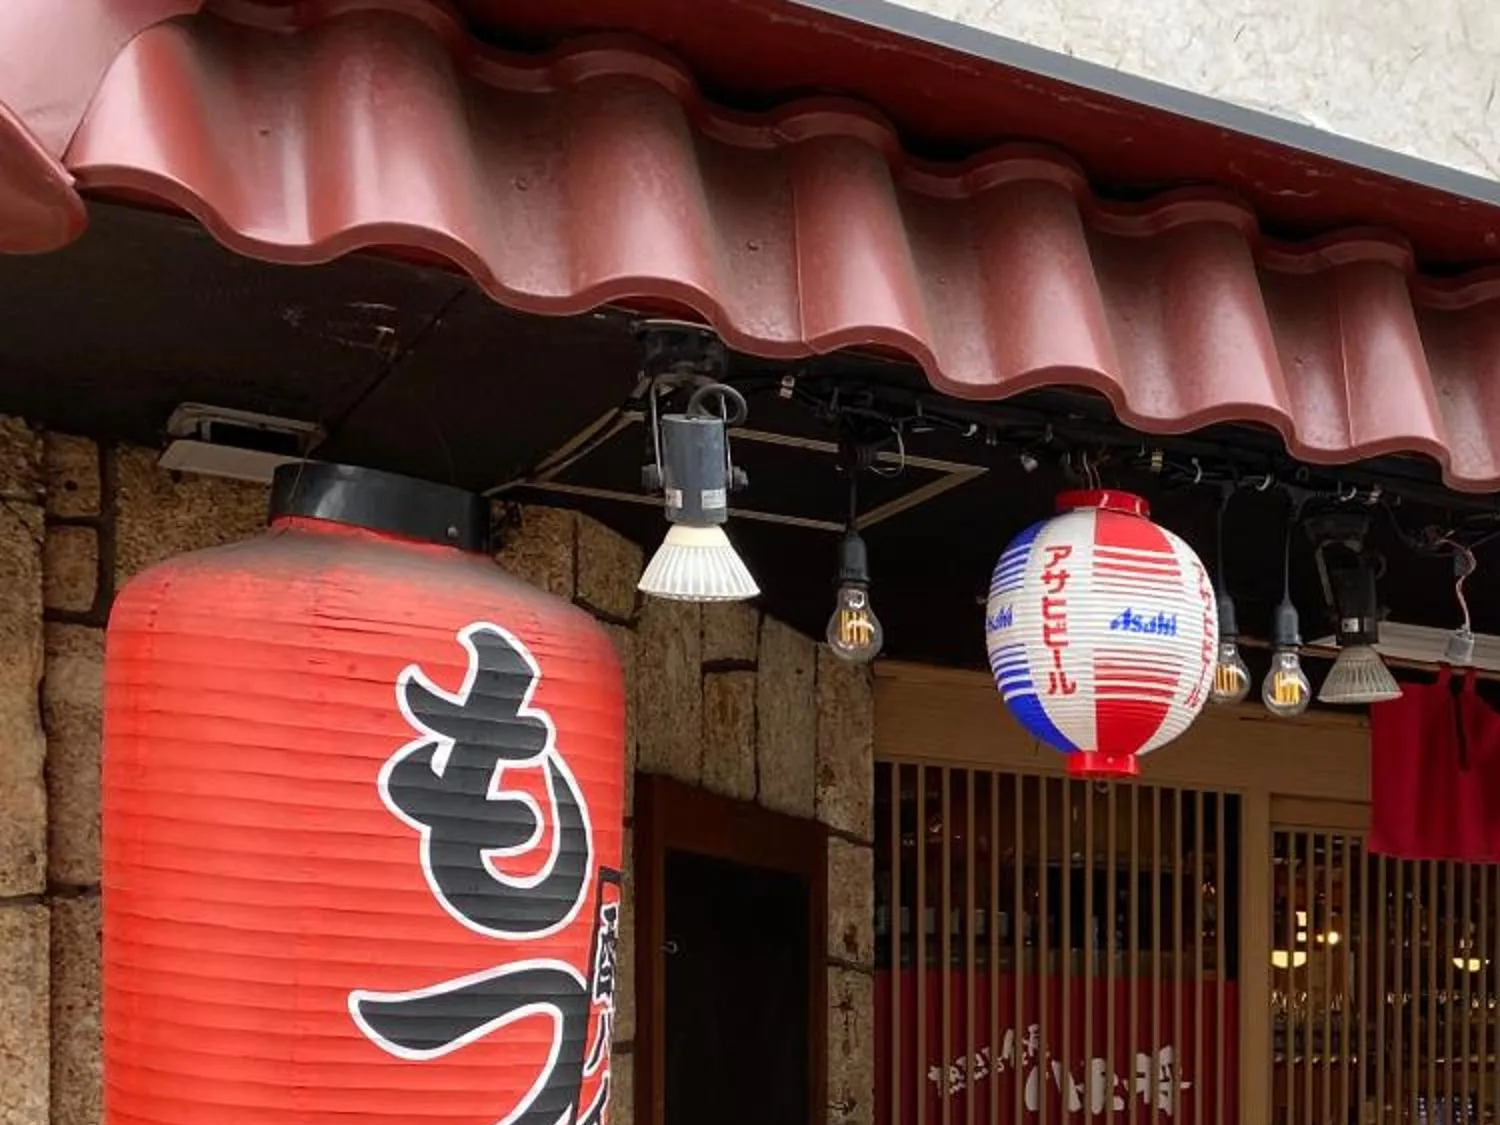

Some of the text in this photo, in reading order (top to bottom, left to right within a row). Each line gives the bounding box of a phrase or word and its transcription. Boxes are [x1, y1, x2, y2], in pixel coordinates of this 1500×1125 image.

[1041, 546, 1076, 695] アサヒビール
[1109, 607, 1177, 637] Asahi
